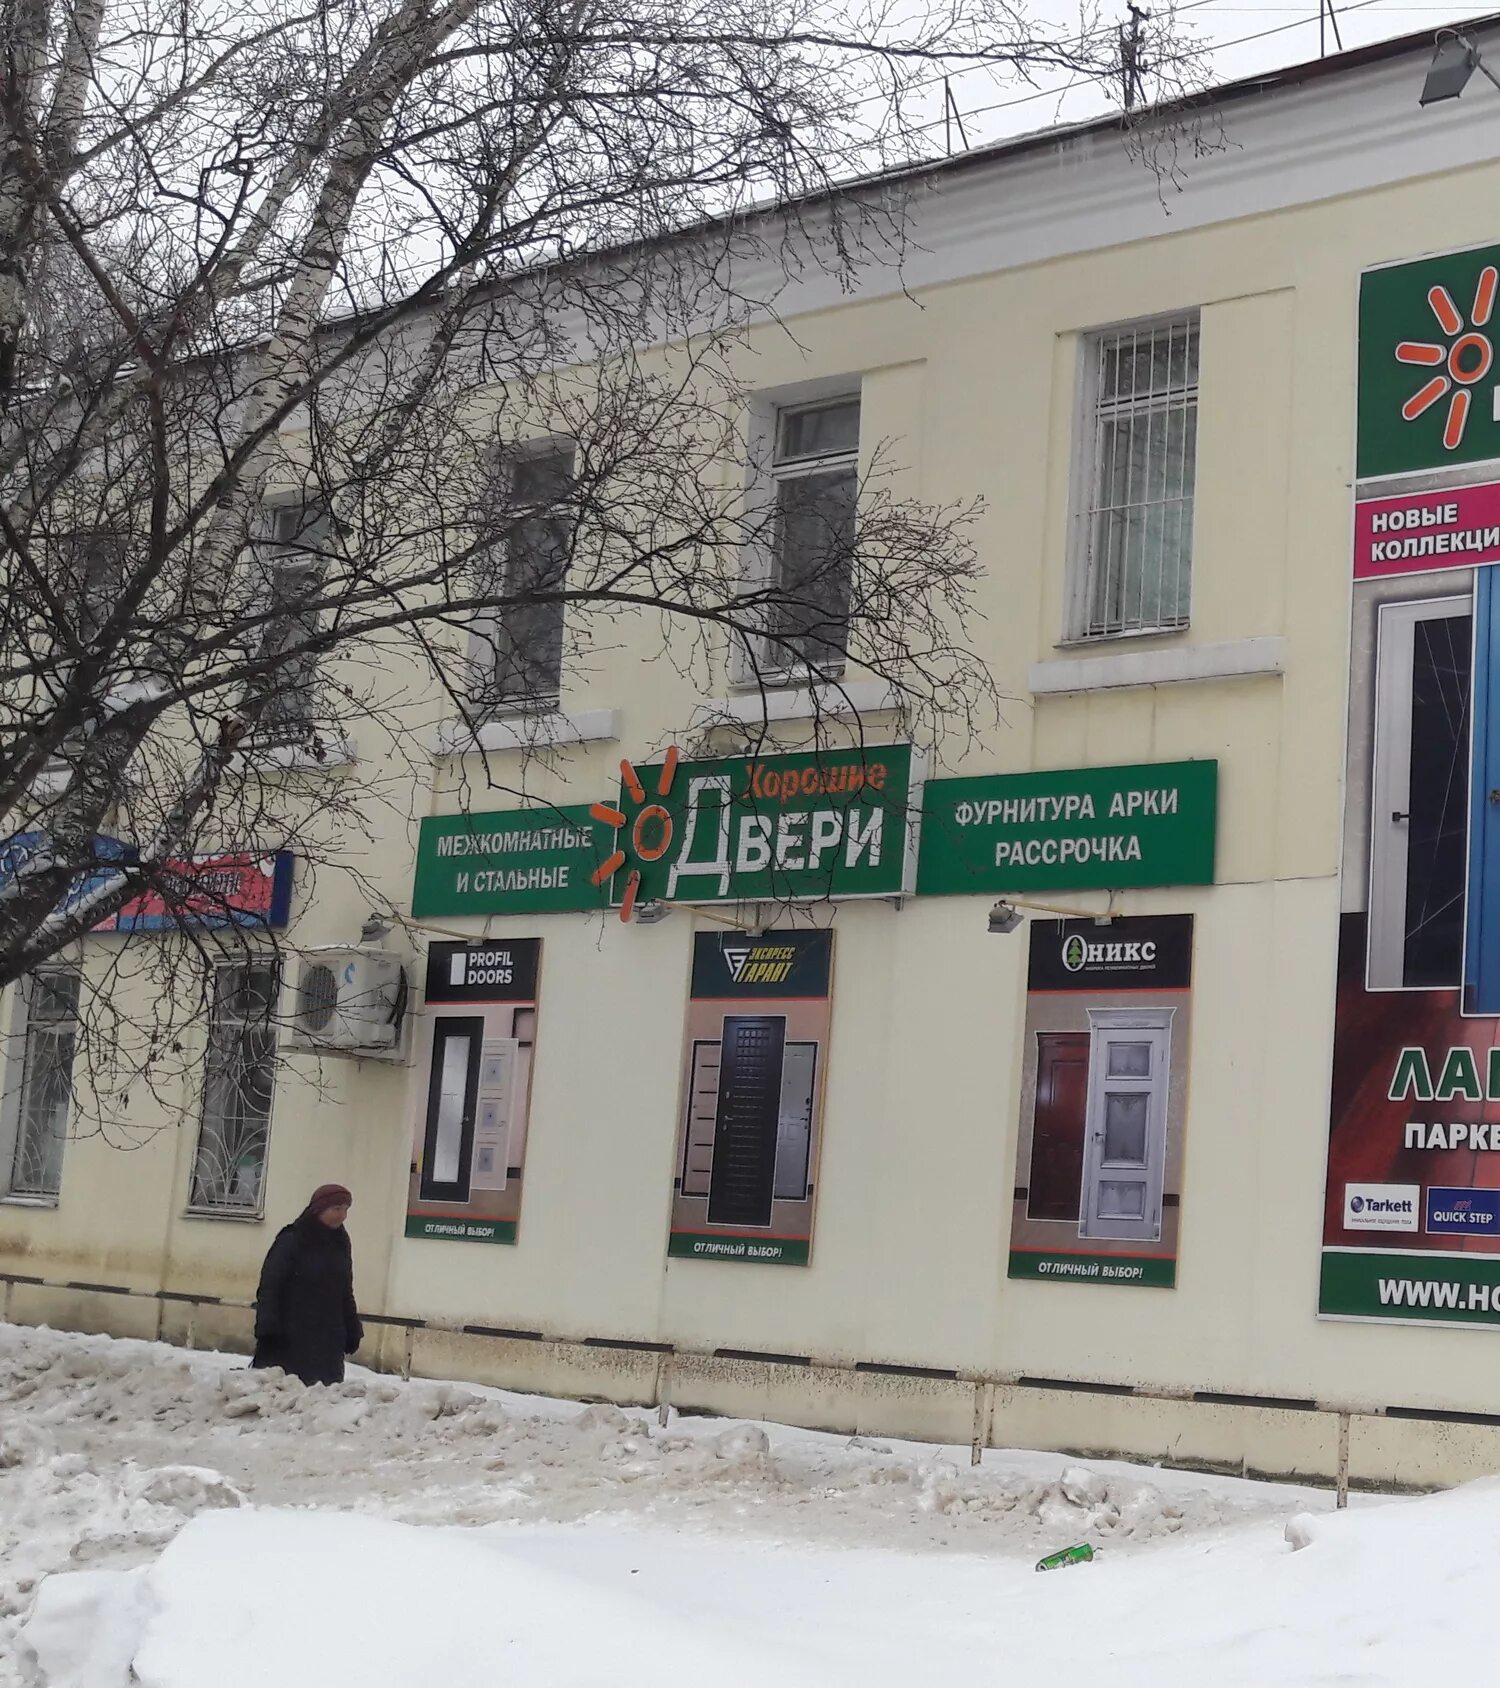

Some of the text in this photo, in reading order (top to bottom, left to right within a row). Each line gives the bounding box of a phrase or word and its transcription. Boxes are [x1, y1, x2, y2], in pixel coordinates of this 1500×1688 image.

[1371, 503, 1459, 534] НОВЫЕ
[743, 762, 888, 802] Хорошие
[954, 788, 1179, 827] ФУРНИТУРА АРКИ
[437, 826, 594, 857] МЕЖКОМНАТНЫЕ
[665, 775, 884, 898] ДВЕРИ
[995, 835, 1142, 867] РАССРОЧКА
[456, 867, 570, 893] И СТАЛЬНЫЕ
[469, 952, 514, 966] PROFIL
[467, 969, 513, 985] DOORS
[1365, 1198, 1412, 1213] Tarkett
[1433, 1210, 1493, 1225] QUICK STEP
[425, 1223, 495, 1237] ОТЛИЧНЫЙ ВЫБОР!
[693, 1241, 783, 1259] ОТЛИЧНЫЙ ВЫБОР!
[1038, 1262, 1144, 1279] ОТЛИЧНЫЙ ВЫБОР!
